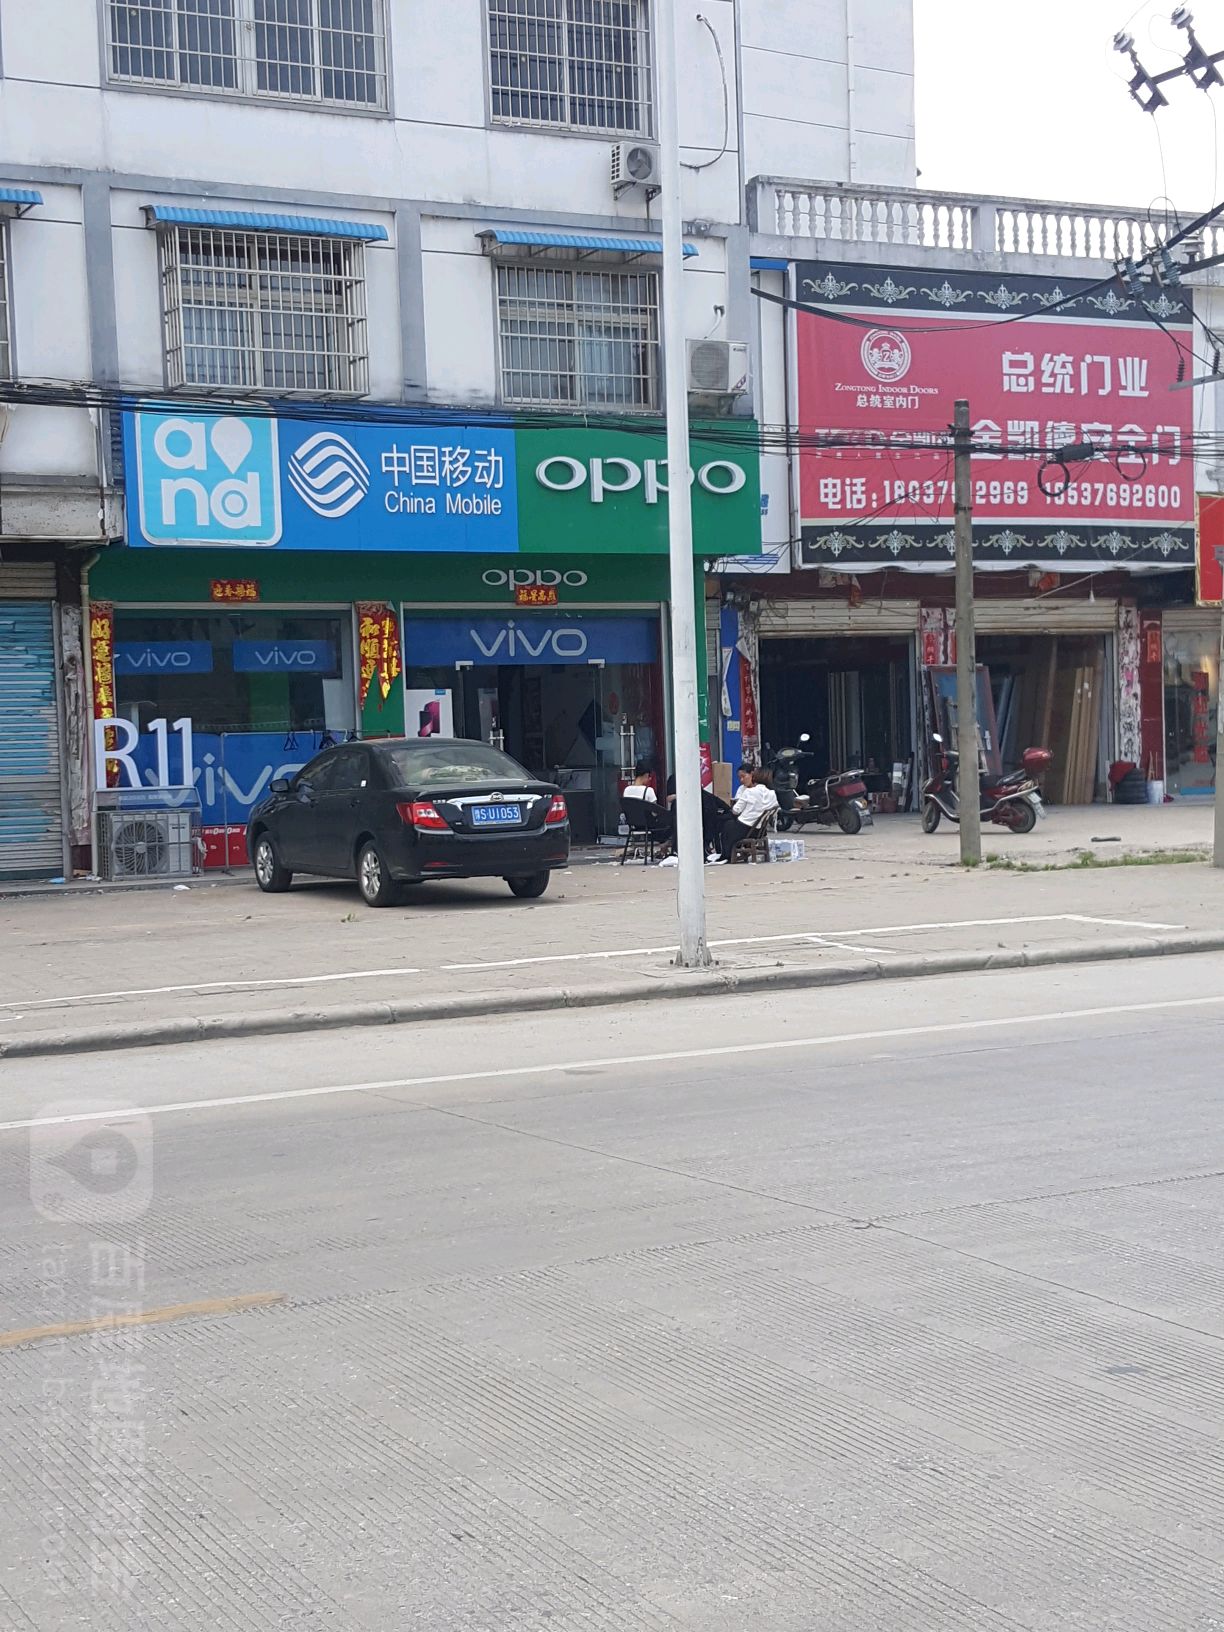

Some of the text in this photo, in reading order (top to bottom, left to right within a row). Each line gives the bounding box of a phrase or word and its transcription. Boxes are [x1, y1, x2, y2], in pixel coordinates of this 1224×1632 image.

[1002, 351, 1149, 398] 总统门业
[856, 394, 919, 409] 总统室内门
[878, 385, 908, 393] INDOOR
[910, 385, 939, 394] DOORS
[380, 443, 504, 490] 中国移动
[384, 490, 502, 515] China Mobile
[470, 619, 588, 658] vivo
[125, 648, 192, 668] vivo
[255, 645, 316, 666] vivo
[94, 717, 195, 790] R11
